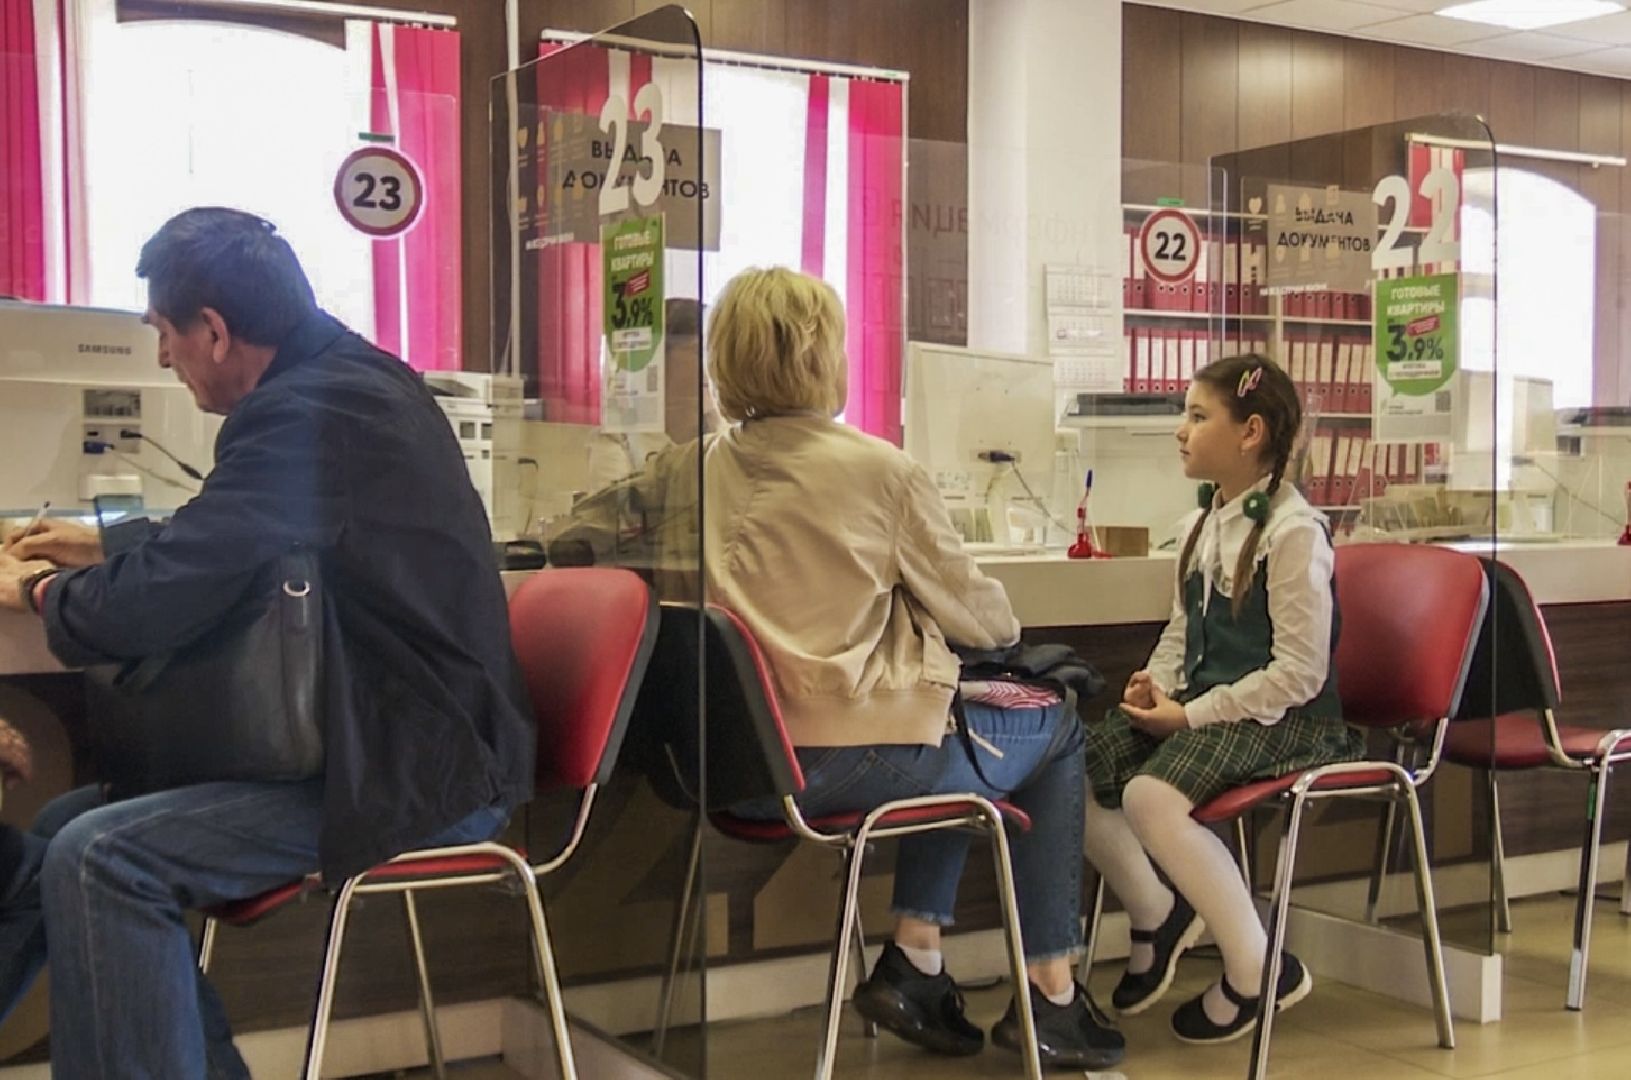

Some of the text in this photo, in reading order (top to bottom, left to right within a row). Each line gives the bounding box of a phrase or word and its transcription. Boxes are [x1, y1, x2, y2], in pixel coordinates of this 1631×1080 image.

[592, 140, 682, 167] ВЫДА
[599, 82, 665, 215] 23
[353, 172, 401, 211] 23
[1371, 167, 1461, 271] 22
[1155, 231, 1186, 261] 22
[77, 343, 132, 355] SAMSUNG
